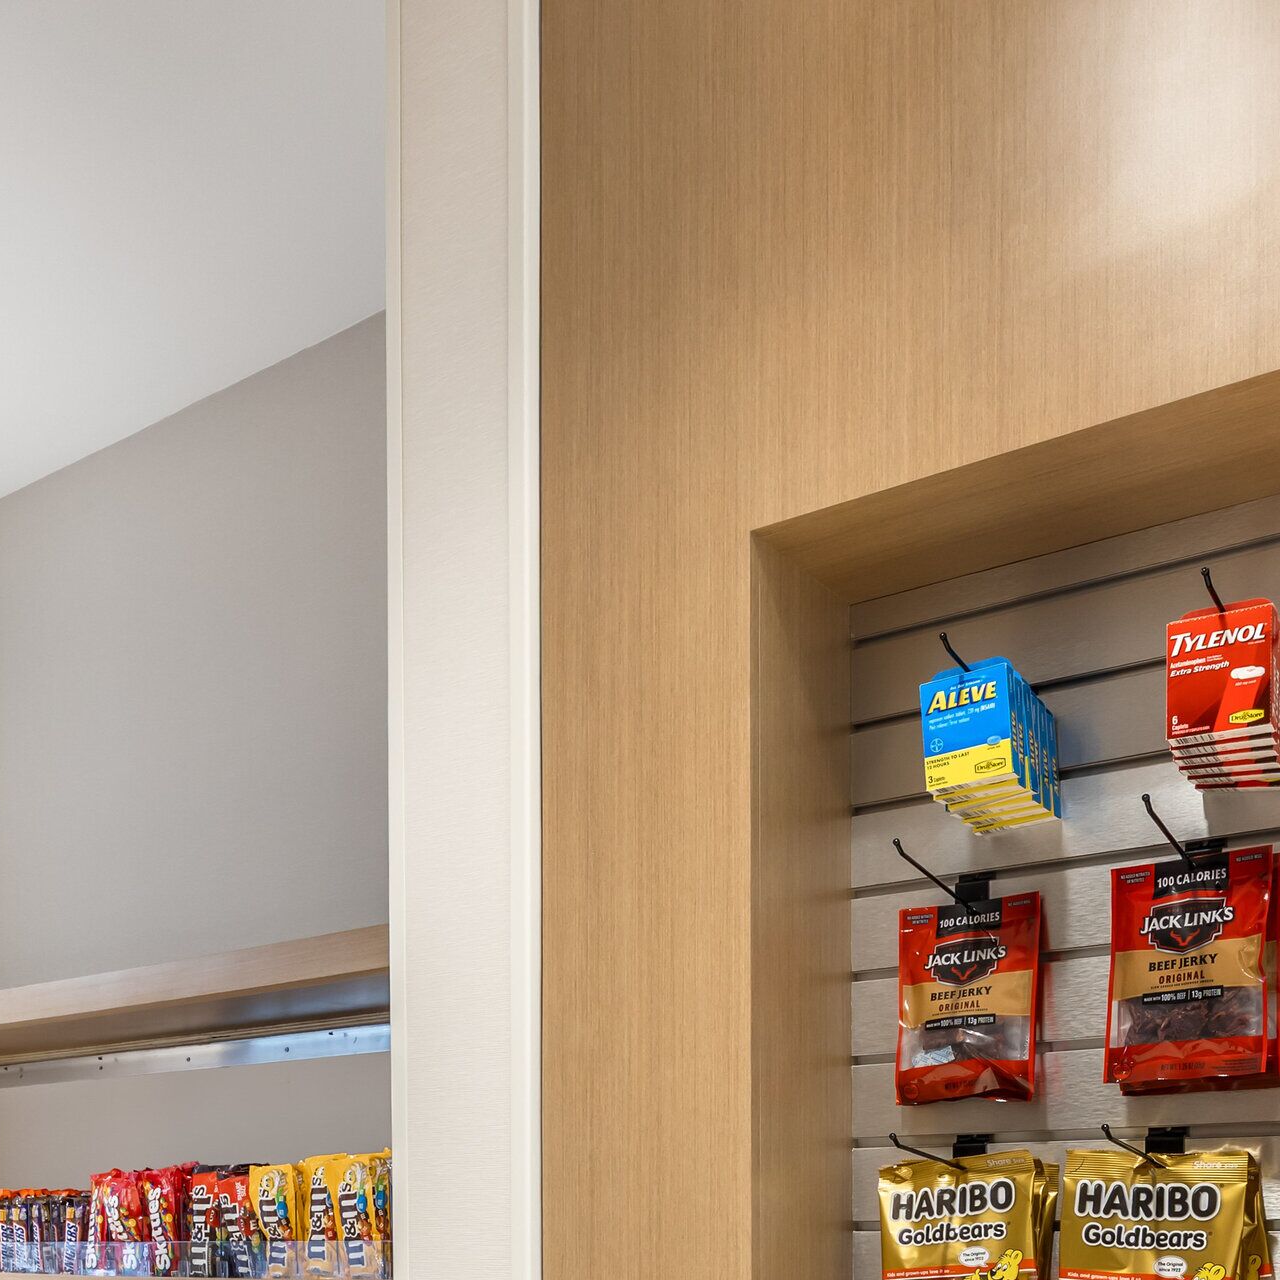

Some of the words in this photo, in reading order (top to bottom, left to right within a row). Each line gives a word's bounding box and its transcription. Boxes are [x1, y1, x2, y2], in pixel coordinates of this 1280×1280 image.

[1170, 623, 1266, 657] TYLENOL
[1170, 667, 1192, 678] Extra
[1193, 660, 1230, 673] Strength
[926, 680, 997, 715] ALEVE
[1172, 715, 1178, 725] 6
[1157, 877, 1175, 888] 100
[1176, 868, 1227, 886] CALORIES
[939, 919, 955, 928] 100
[956, 912, 1000, 926] CALORIES
[1140, 914, 1183, 934] JACK
[1184, 906, 1234, 927] LINK'S
[925, 953, 962, 969] JACK
[963, 946, 1007, 963] LINK'S
[1149, 958, 1178, 972] BEEF
[1179, 953, 1218, 970] JERKY
[1158, 971, 1205, 985] ORIGINAL
[931, 990, 956, 1001] BEEF
[957, 986, 992, 999] JERKY
[939, 1000, 980, 1012] ORIGINAL
[891, 1179, 1015, 1221] HARIBO
[1077, 1182, 1219, 1220] HARIBO
[898, 1223, 1006, 1245] Goldbears
[1084, 1223, 1206, 1249] Goldbears
[64, 1220, 78, 1275] SNICKERS
